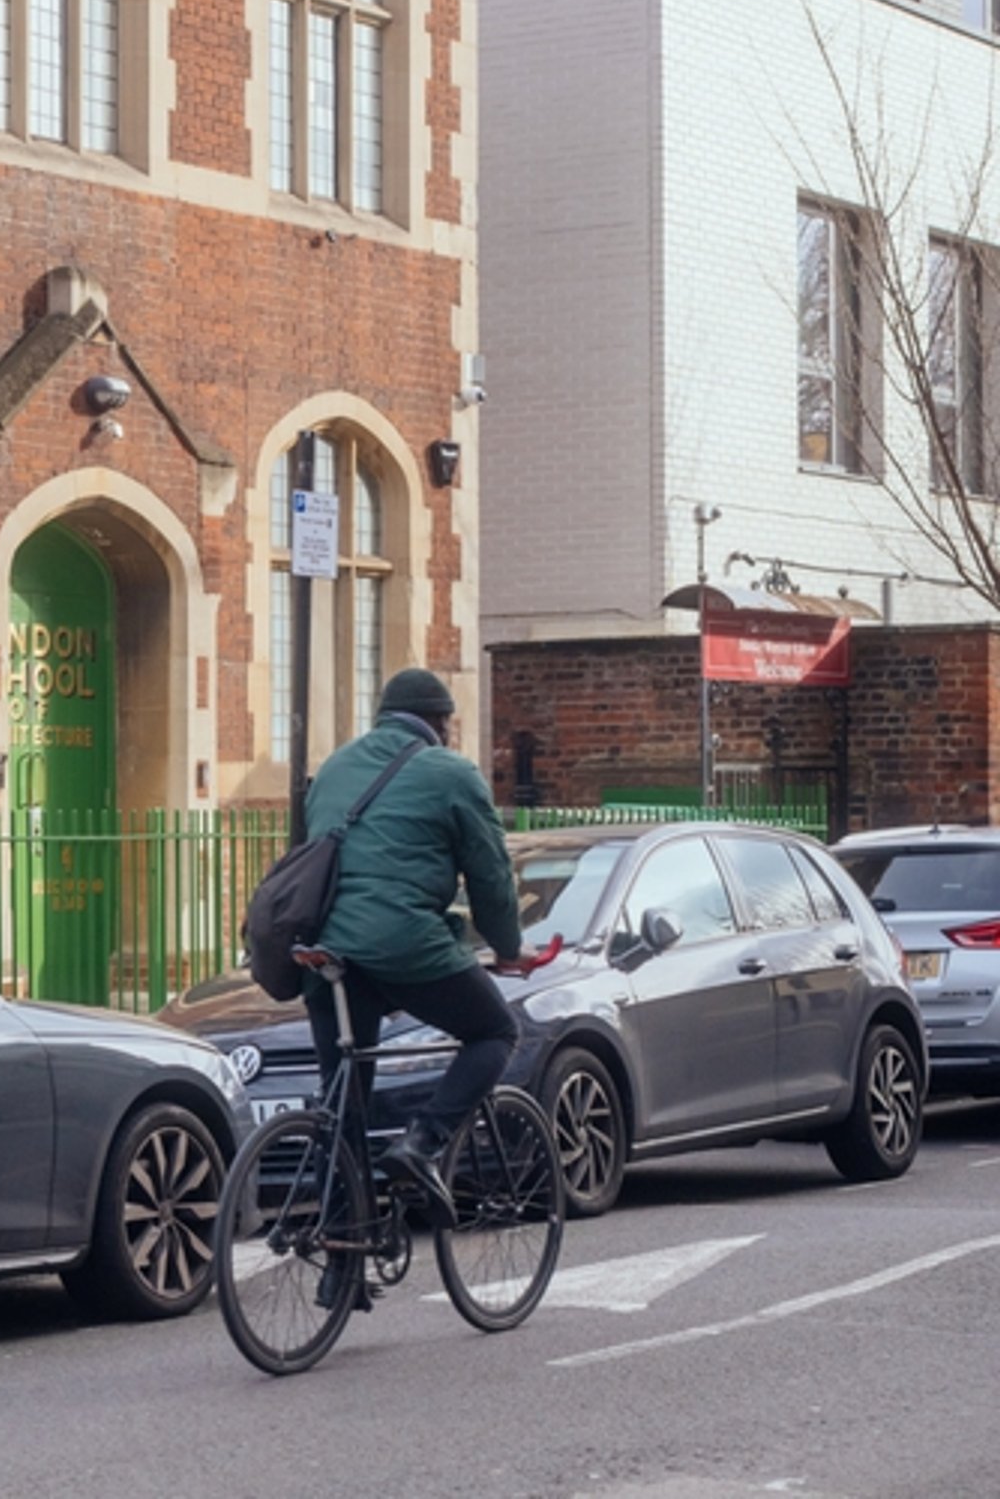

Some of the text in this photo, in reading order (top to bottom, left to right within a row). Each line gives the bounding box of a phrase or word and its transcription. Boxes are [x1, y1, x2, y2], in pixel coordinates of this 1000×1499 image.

[8, 622, 95, 661] NDON
[6, 660, 95, 699] HOOL
[10, 724, 94, 749] ITECTURE
